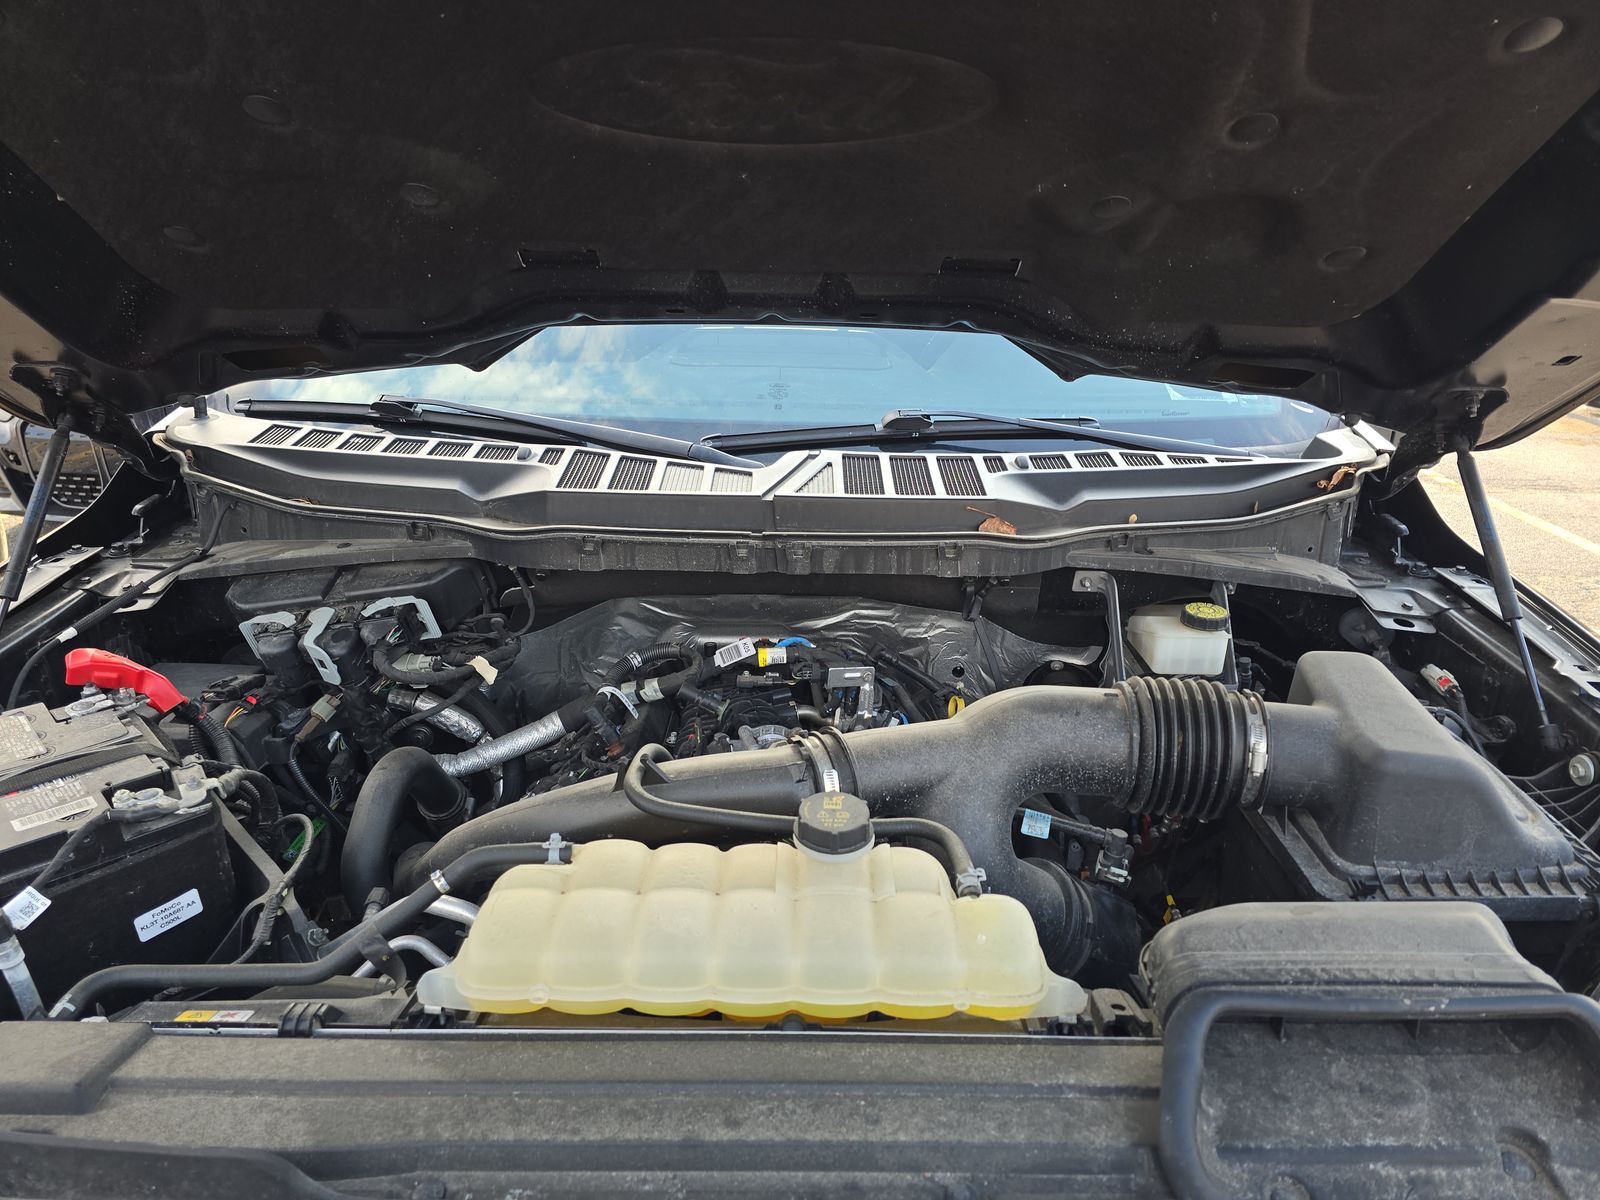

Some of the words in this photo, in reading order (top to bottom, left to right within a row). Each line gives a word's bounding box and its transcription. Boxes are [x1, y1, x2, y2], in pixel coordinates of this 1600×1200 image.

[152, 902, 182, 918] FoMoCo
[140, 919, 159, 932] KL3T
[159, 915, 182, 929] C500L
